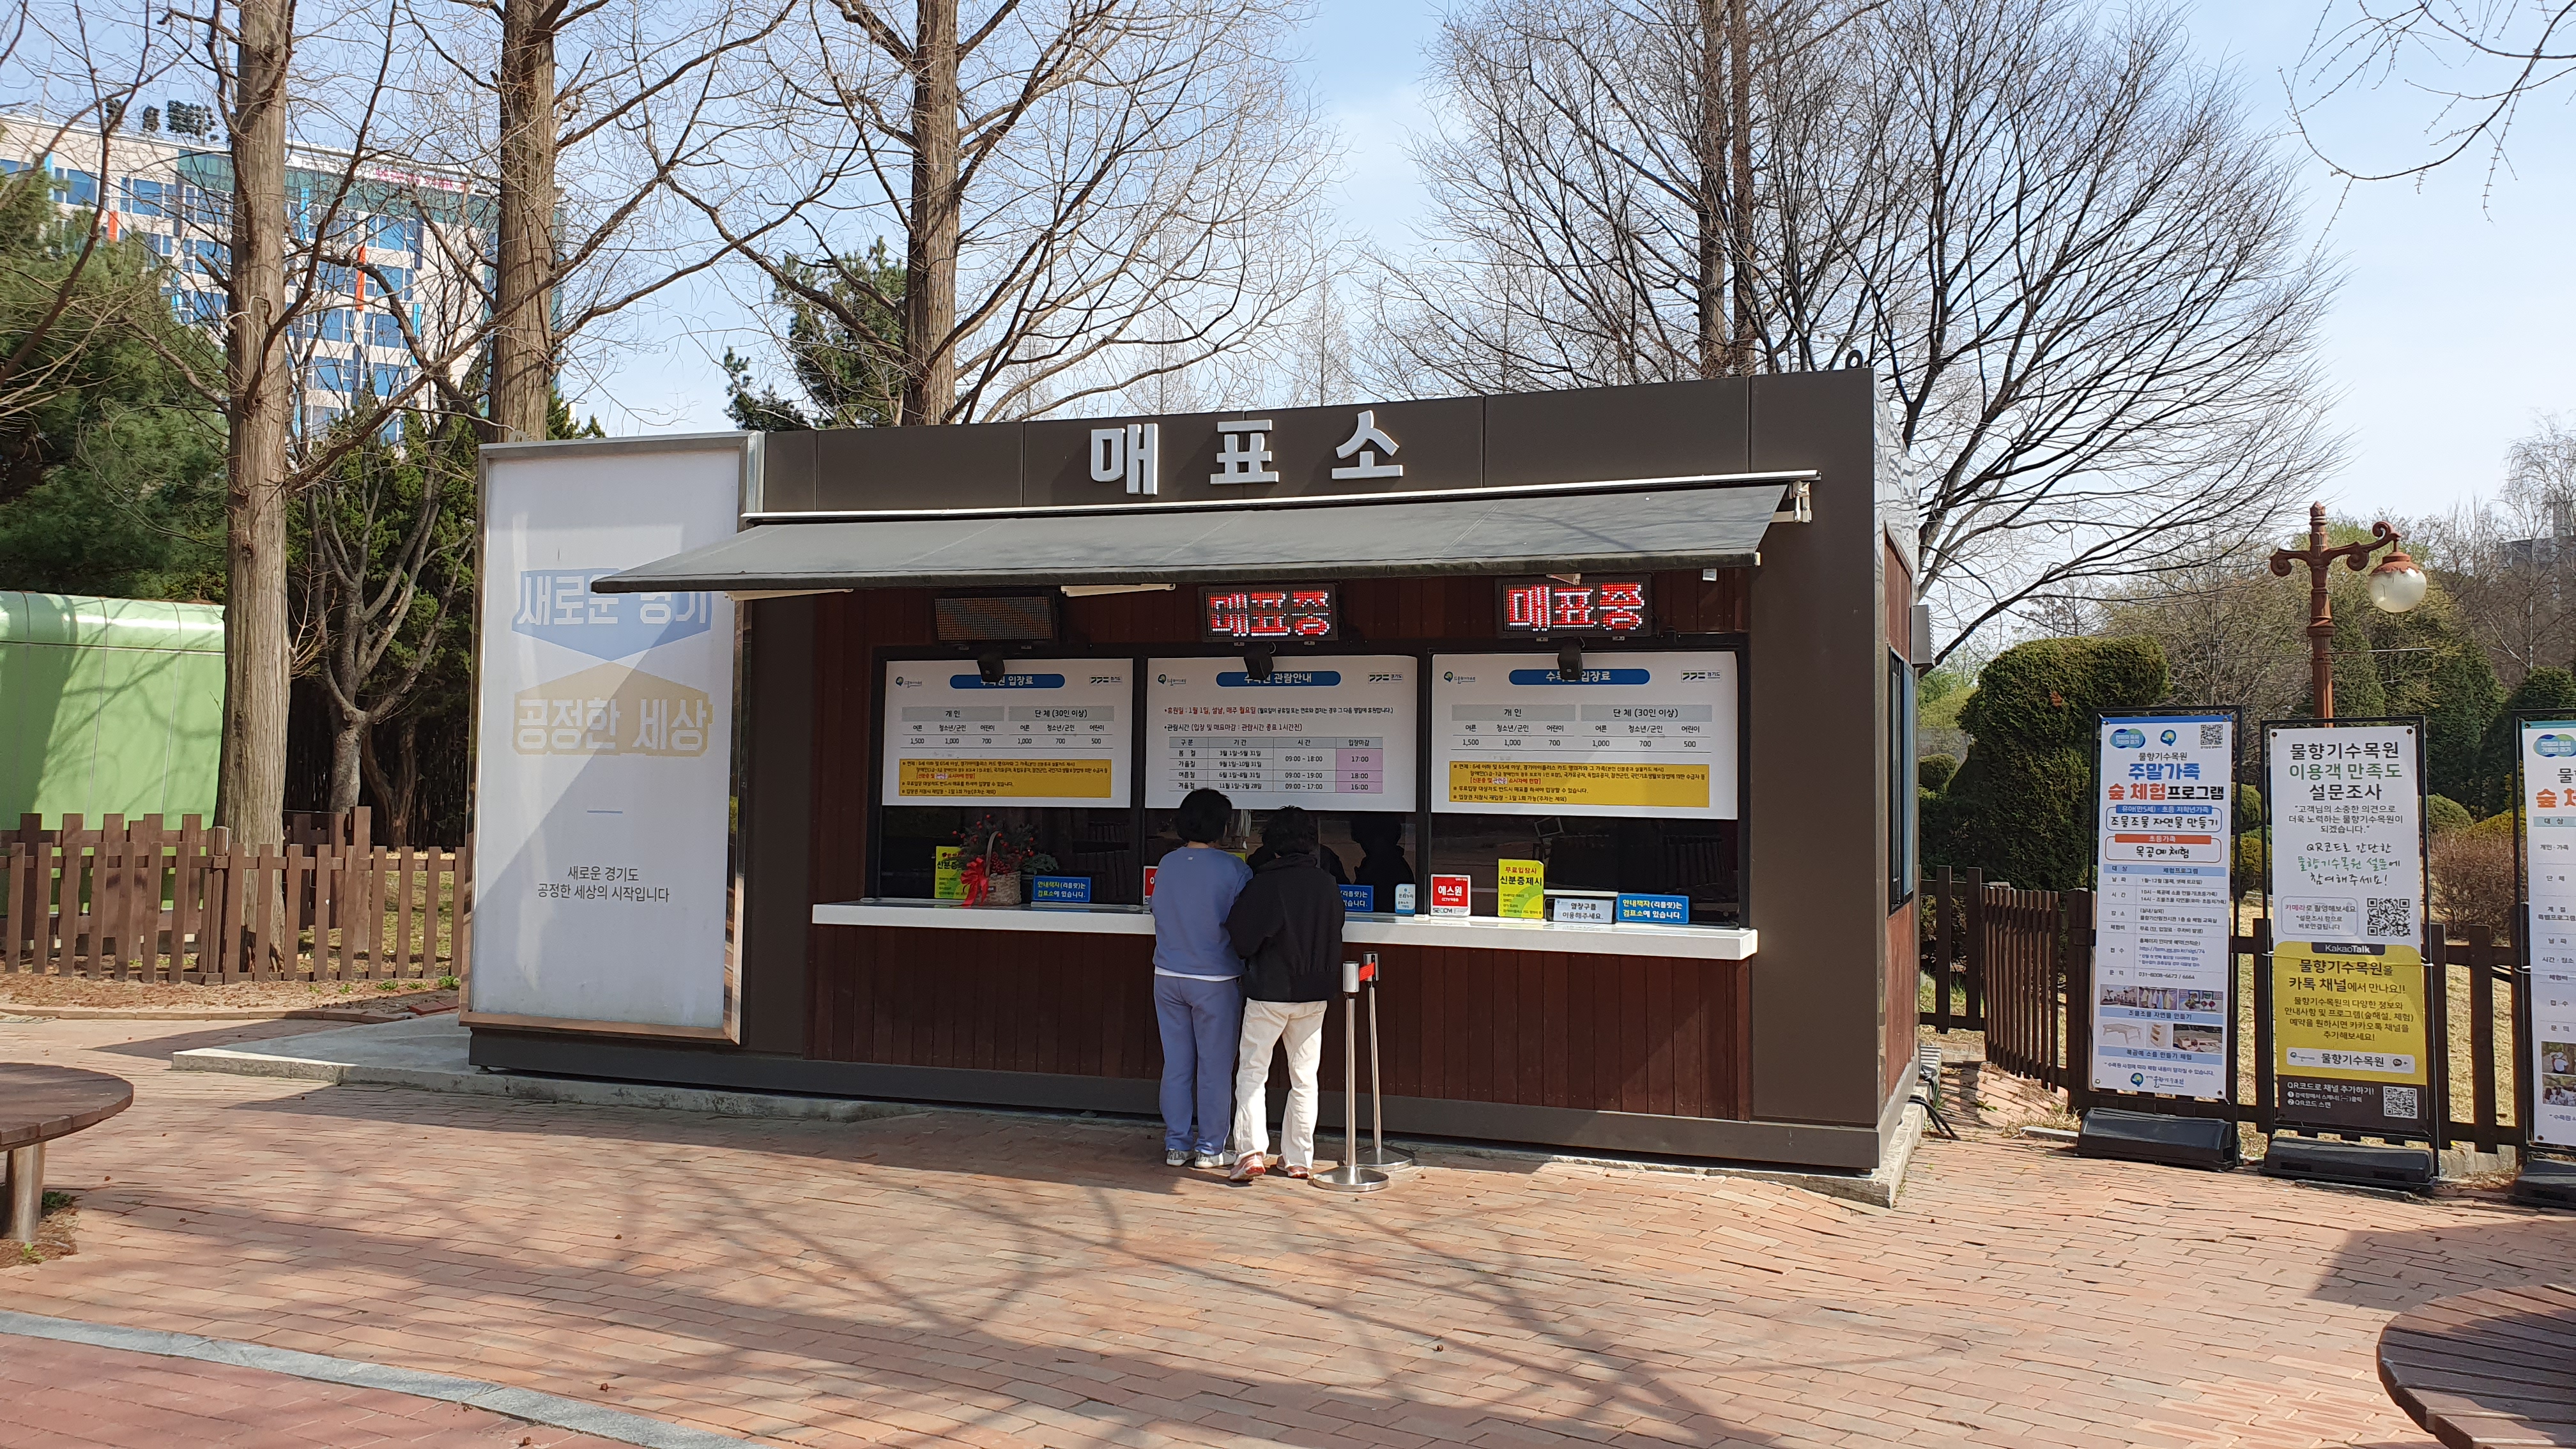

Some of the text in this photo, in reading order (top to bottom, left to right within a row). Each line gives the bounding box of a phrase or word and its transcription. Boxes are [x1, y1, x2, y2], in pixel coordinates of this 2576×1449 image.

[1210, 591, 1331, 636] 매표중
[1508, 583, 1645, 631] 매표중
[1009, 676, 1034, 686] 입장료
[1274, 673, 1312, 684] 관람안내
[1581, 671, 1611, 682] 입장료
[1634, 709, 1678, 718] (30인 이상)
[518, 697, 707, 751] 공정한 세상
[1681, 725, 1700, 733] 어린이
[2138, 752, 2187, 761] 물향기수목원
[2290, 742, 2398, 760] 물향기수목원
[2128, 763, 2200, 780] 주말가족
[2290, 763, 2402, 780] 이용객 만족도
[2108, 783, 2224, 801] 숲 체험프로그램
[2310, 784, 2382, 801] 설문조사
[2536, 788, 2557, 808] 숲
[2111, 816, 2218, 829] 조물조물 자연물 만들기
[2289, 815, 2403, 824] 더욱 노력하는 물향기수목원이
[2136, 846, 2189, 859] 목공예 체험
[2306, 842, 2392, 853] QR코드로 간단한
[2297, 856, 2400, 871] 물향기수목원 설문에
[567, 866, 639, 882] 새로운 경기도
[2310, 872, 2388, 886] 참여해주세요!
[1500, 876, 1542, 886] 신분증제시
[538, 884, 670, 903] 공정한 세상의 시작입니다
[1438, 885, 1462, 896] 에스원
[1623, 899, 1682, 909] 안내책자(리플릿)는
[1562, 912, 1604, 920] 이용해주세요.
[1623, 910, 1682, 919] 검표소에 있습니다.
[2325, 944, 2371, 953] KakaoTalk
[2299, 959, 2393, 976] 물향기수목원을
[2289, 977, 2406, 994] 카톡 채널에서 만나요!!
[2294, 997, 2403, 1009] 물향기수목원의 다양한 정보와
[2285, 1007, 2316, 1016] 안내사항
[2394, 1013, 2414, 1022] 체험)
[2289, 1018, 2409, 1033] 예약을 원하시면 카카오톡 채널을
[2321, 1053, 2384, 1068] 물향기수목원
[2287, 1082, 2374, 1095] QR코드로 채널 추가하기!
